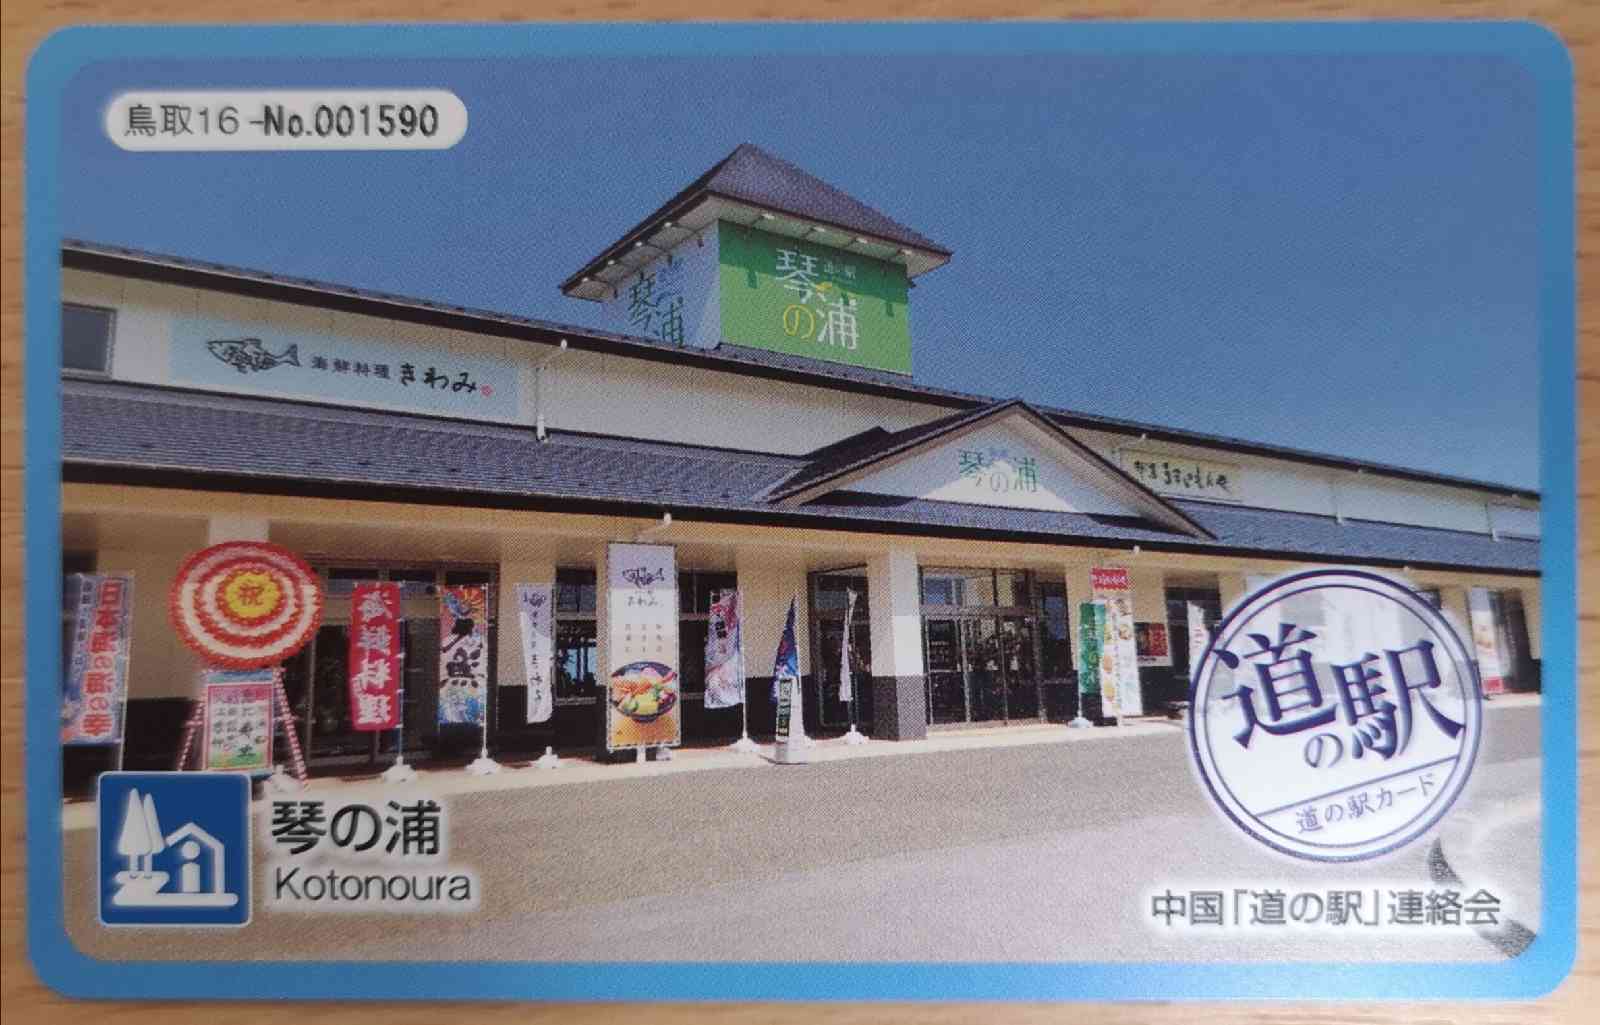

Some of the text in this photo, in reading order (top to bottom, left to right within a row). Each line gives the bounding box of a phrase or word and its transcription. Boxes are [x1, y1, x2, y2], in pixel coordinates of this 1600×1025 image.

[399, 362, 478, 393] きわみ
[1295, 773, 1437, 834] 道の駅カード
[271, 799, 442, 856] 琴の浦
[275, 867, 471, 901] Kotonoura
[1150, 888, 1502, 927] 中国「道の駅」連絡会
